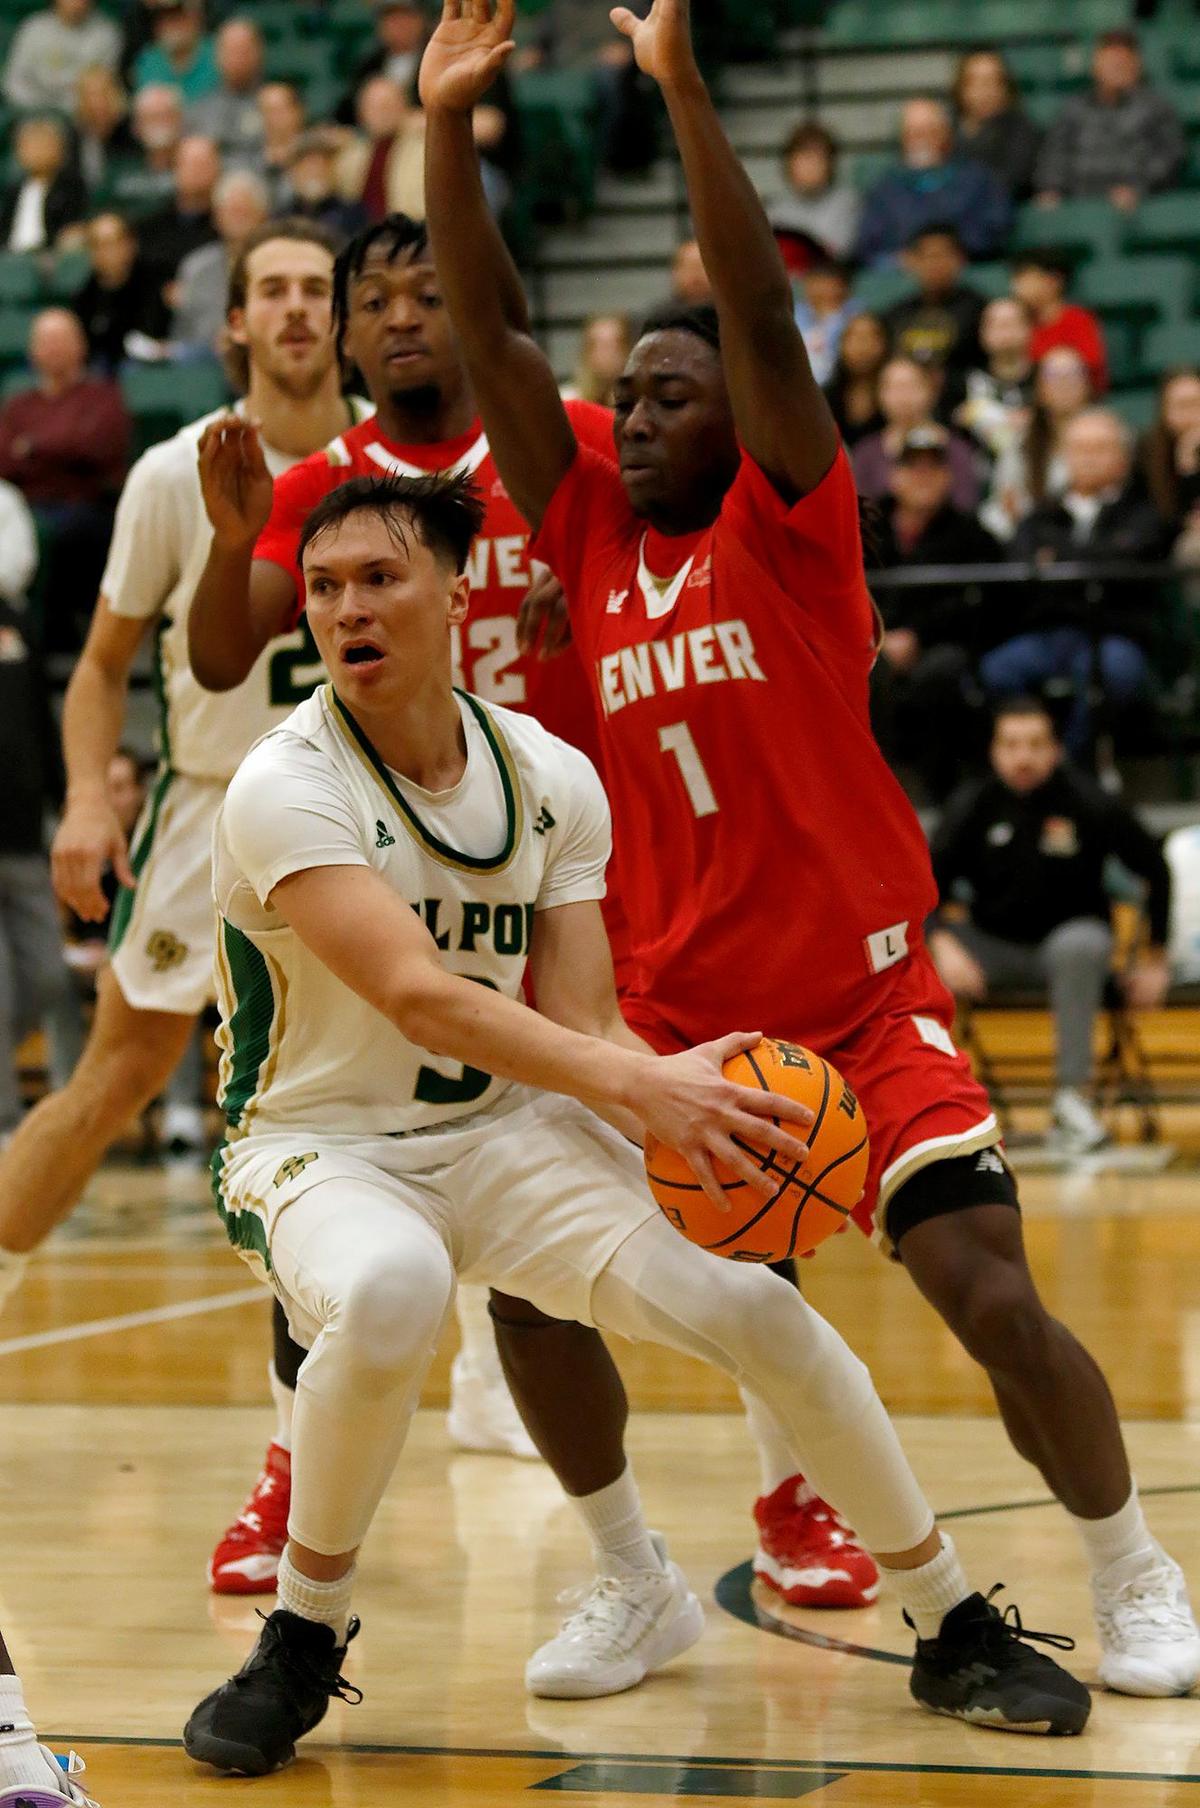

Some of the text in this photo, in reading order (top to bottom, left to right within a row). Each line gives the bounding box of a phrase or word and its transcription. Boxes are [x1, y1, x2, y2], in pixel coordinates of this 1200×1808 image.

[597, 619, 768, 720] ENVER
[657, 720, 720, 819] 1
[885, 935, 896, 956] L
